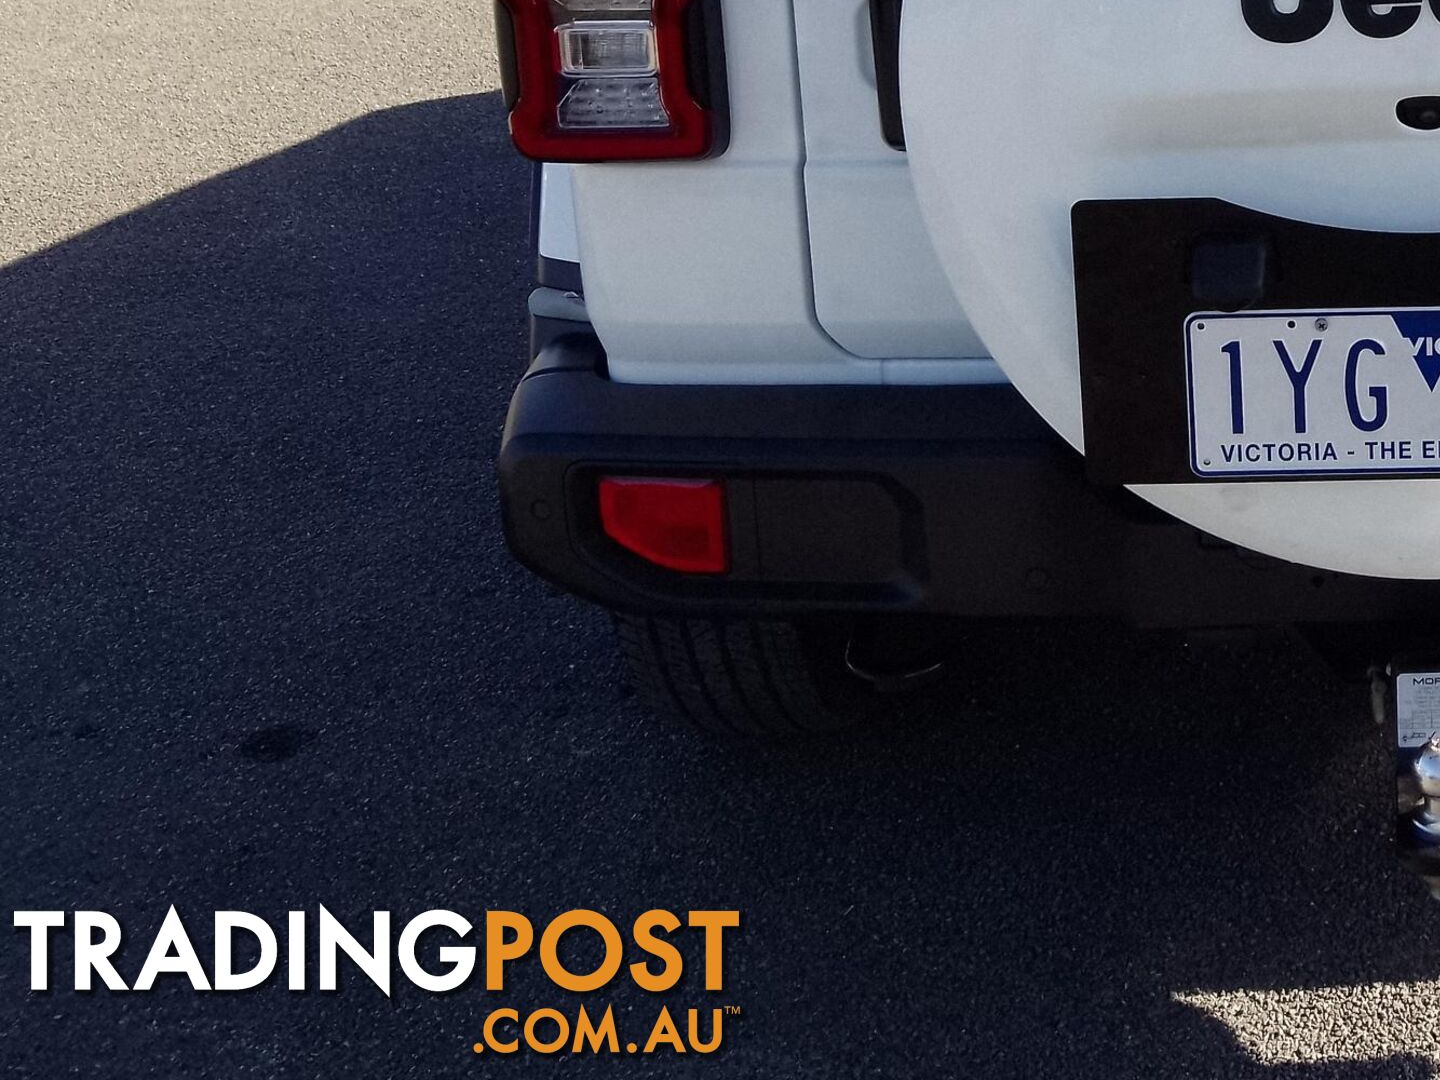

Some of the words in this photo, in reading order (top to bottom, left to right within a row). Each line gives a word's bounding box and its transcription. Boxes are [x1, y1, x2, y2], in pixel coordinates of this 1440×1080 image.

[1221, 338, 1389, 434] 1YG
[1221, 442, 1338, 463] VICTORIA
[1365, 440, 1412, 460] THE
